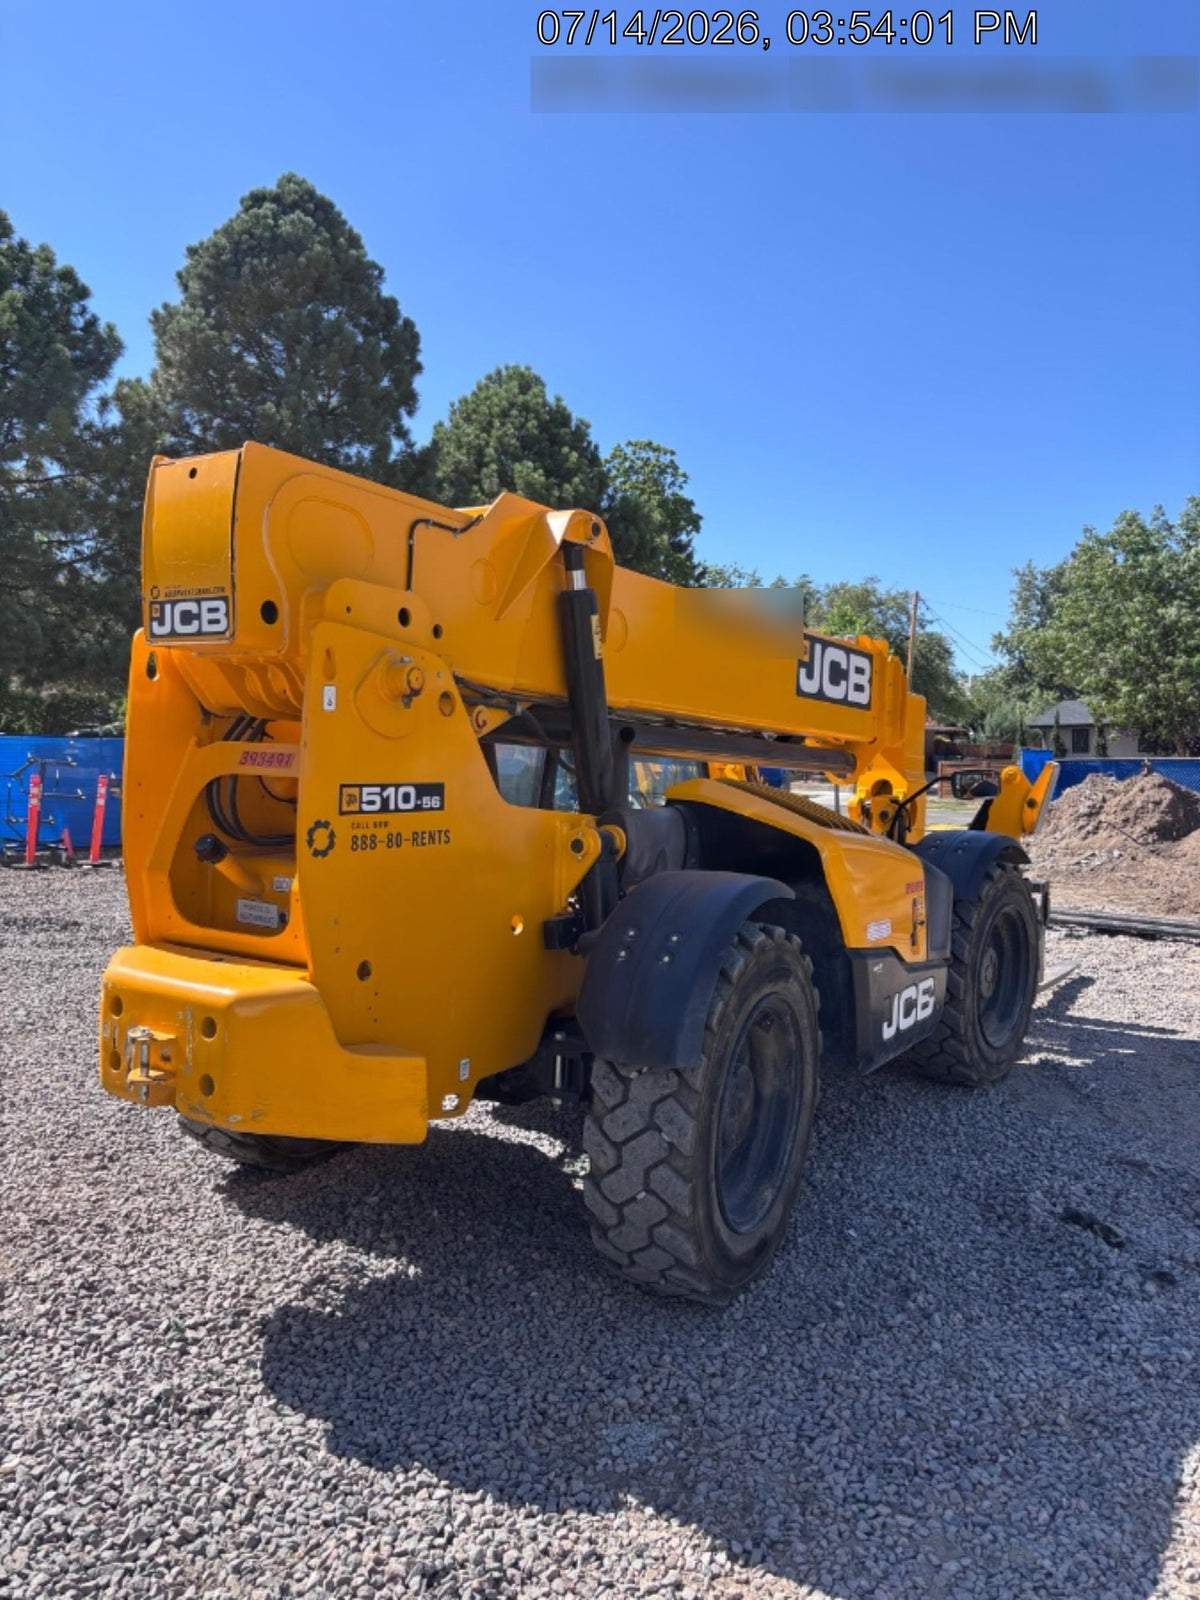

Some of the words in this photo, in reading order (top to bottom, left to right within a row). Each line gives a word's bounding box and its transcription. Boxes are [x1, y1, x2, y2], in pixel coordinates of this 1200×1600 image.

[152, 600, 228, 636] JCB
[799, 643, 872, 705] JCB
[361, 785, 441, 811] 510-56
[350, 828, 450, 852] 888-80-RENTS
[882, 977, 935, 1040] JCB
